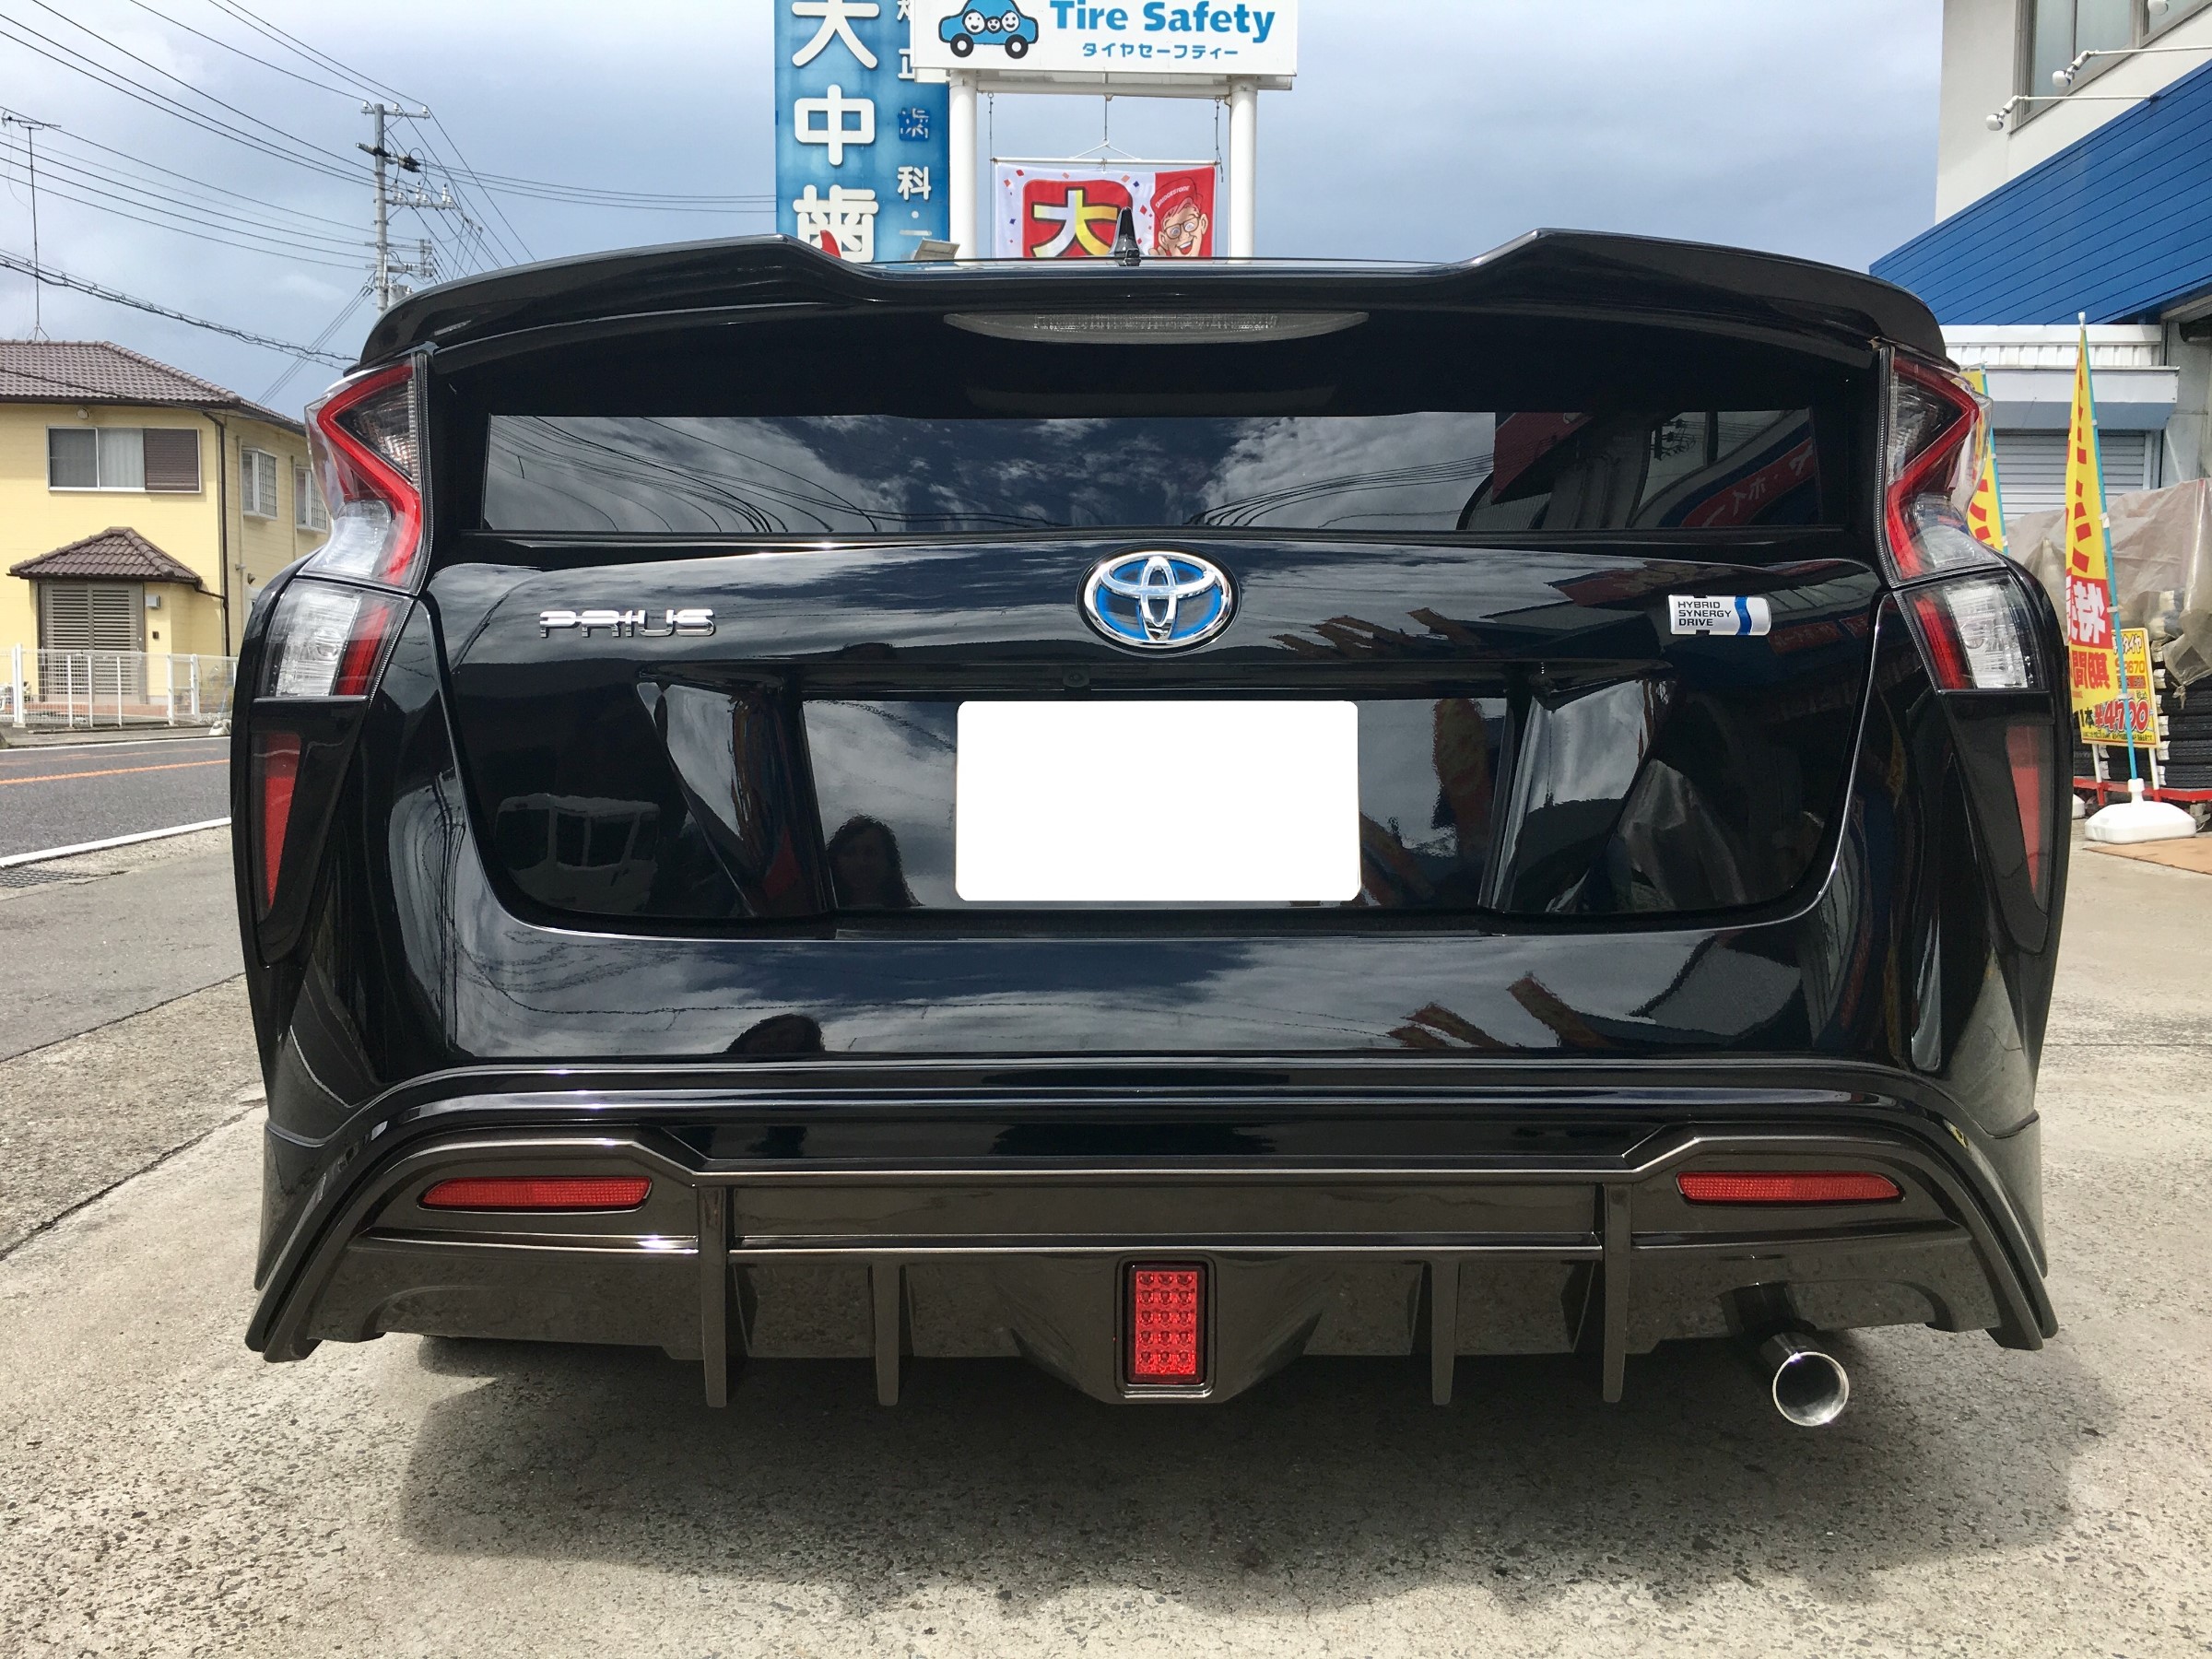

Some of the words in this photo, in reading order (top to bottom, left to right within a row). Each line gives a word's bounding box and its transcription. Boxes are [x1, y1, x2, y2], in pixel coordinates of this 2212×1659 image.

[1050, 0, 1128, 30] Tire
[1143, 1, 1276, 43] Safety
[1082, 42, 1238, 59] タイヤセーフティー
[540, 609, 714, 638] PRIUS
[1678, 618, 1713, 627] DRIVE
